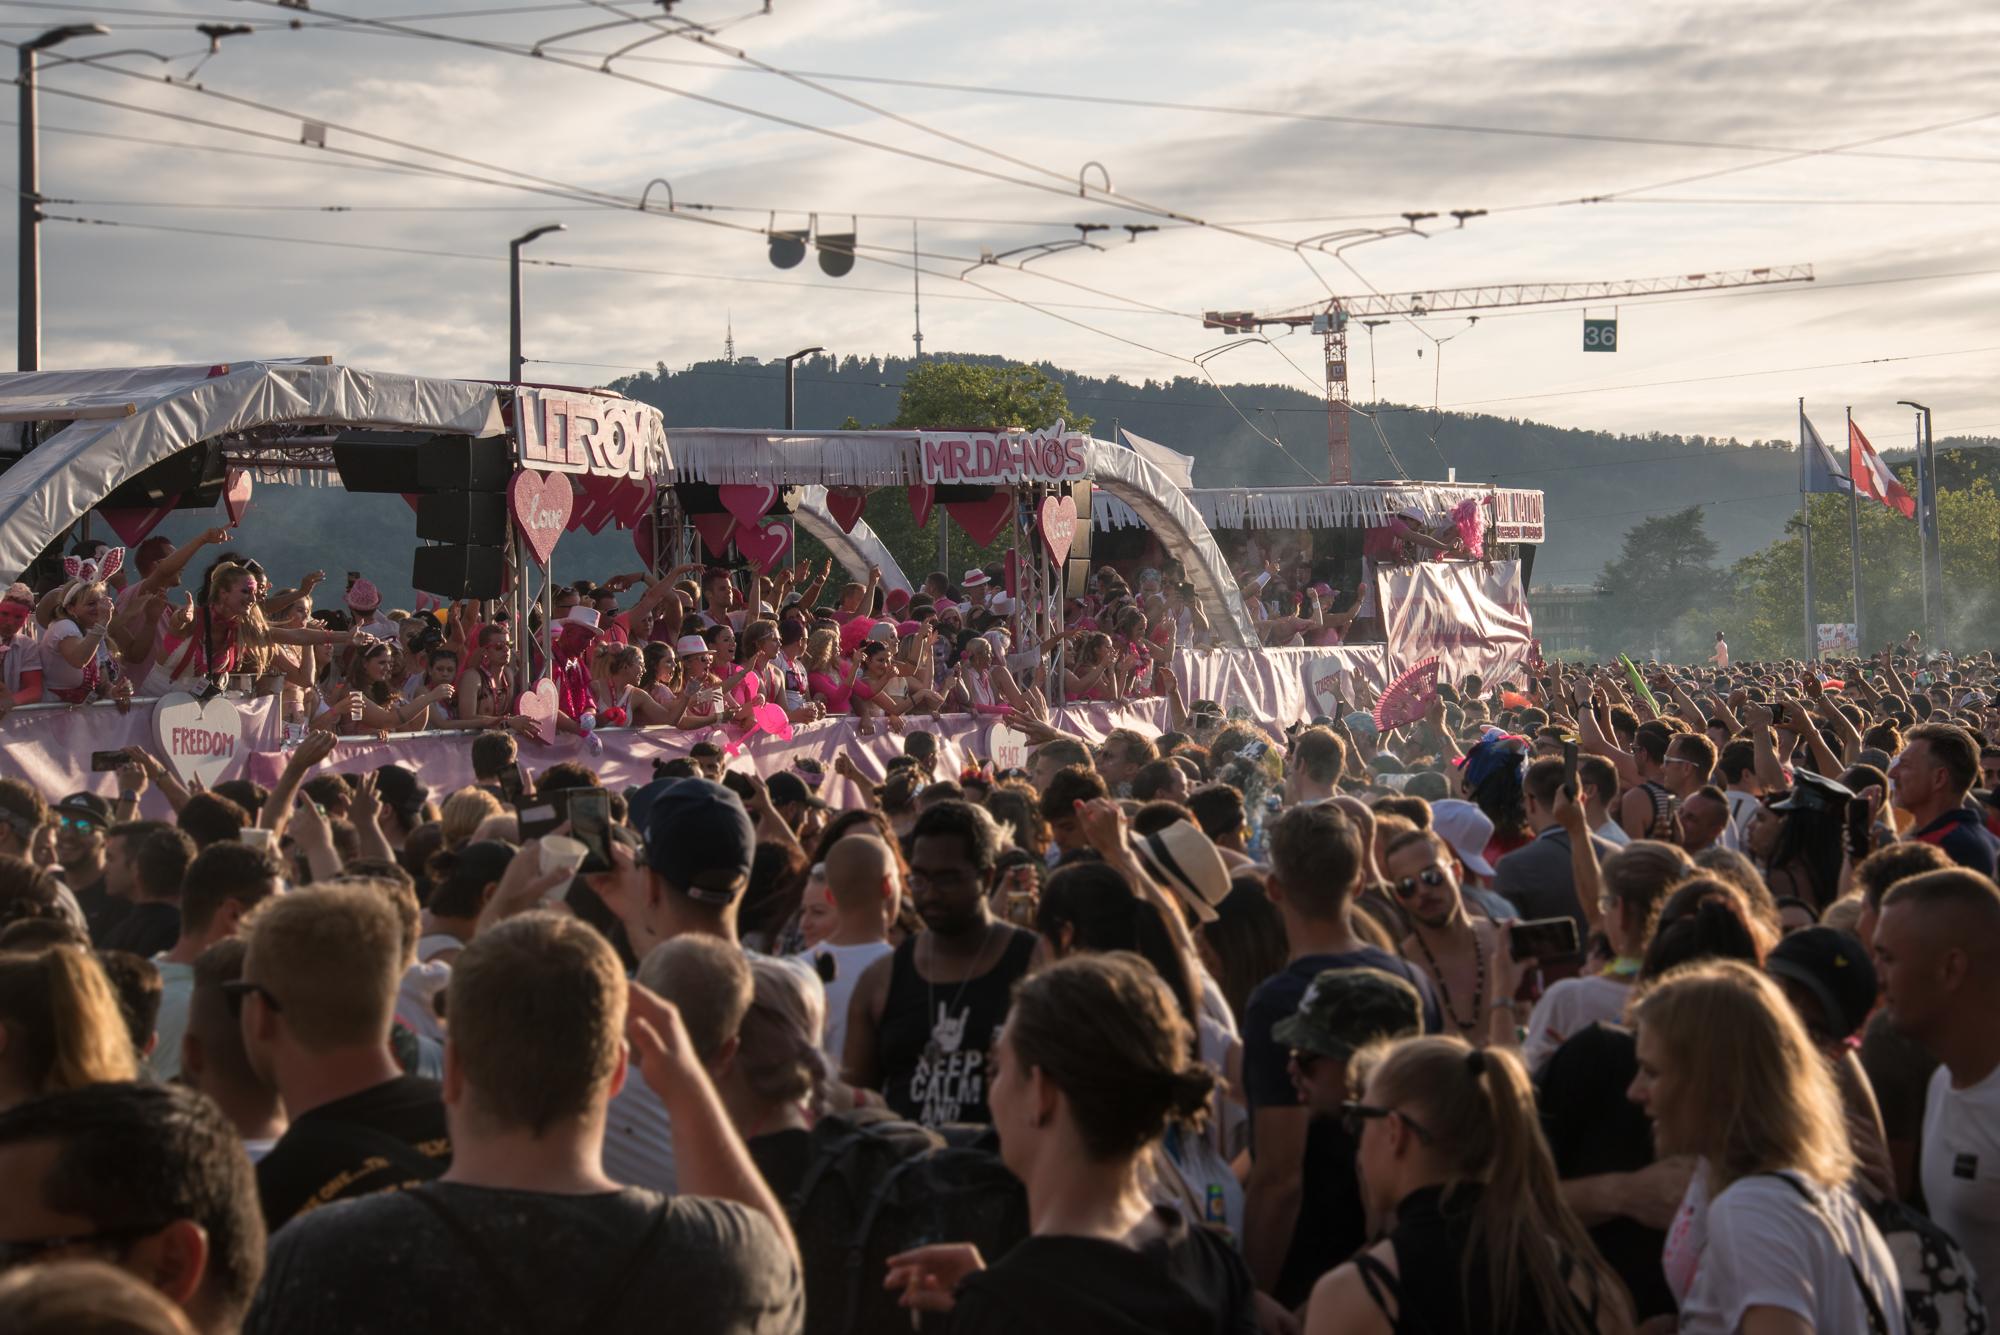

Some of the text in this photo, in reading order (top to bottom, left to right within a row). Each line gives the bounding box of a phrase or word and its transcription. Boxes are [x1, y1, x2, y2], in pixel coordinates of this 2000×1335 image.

[1585, 326, 1615, 346] 36
[521, 395, 651, 472] LEROY
[172, 727, 234, 758] FREEDOM
[910, 1075, 981, 1103] CALM
